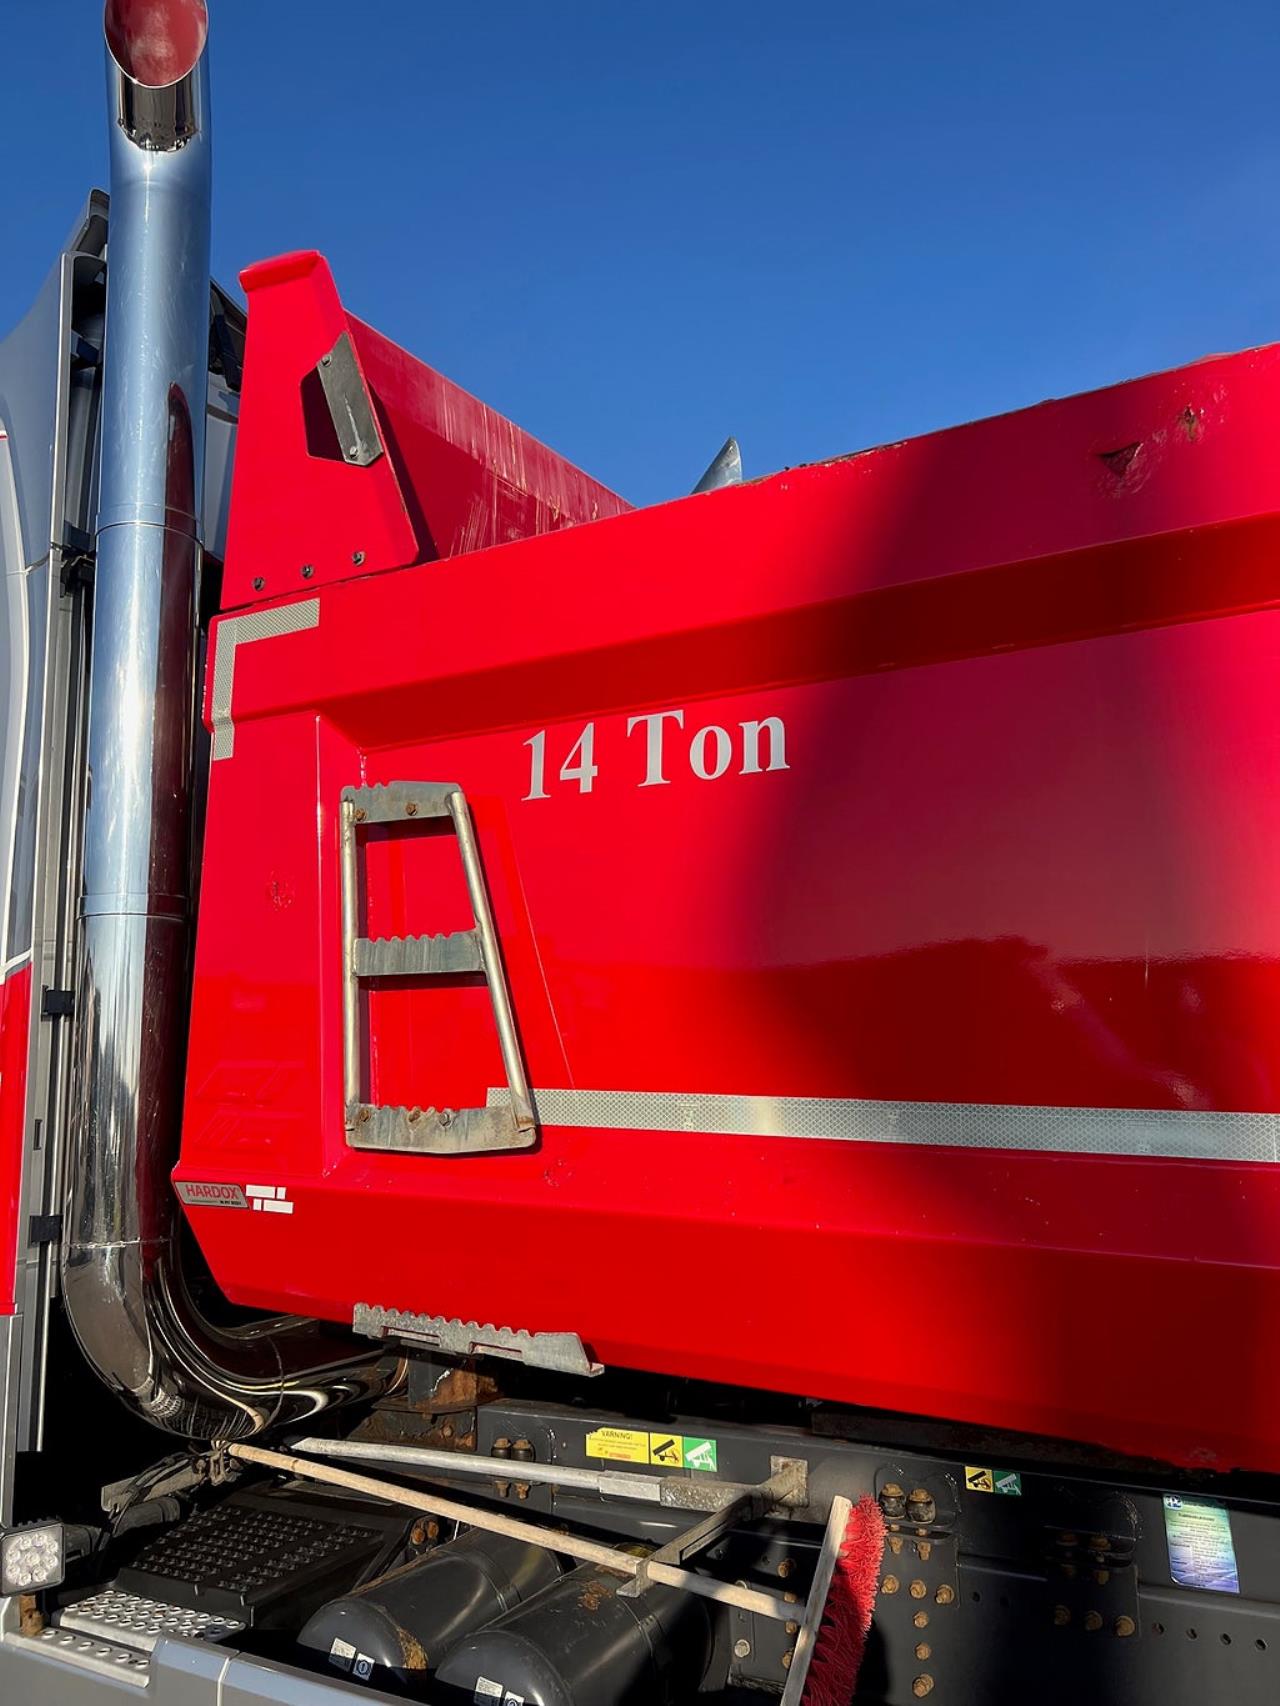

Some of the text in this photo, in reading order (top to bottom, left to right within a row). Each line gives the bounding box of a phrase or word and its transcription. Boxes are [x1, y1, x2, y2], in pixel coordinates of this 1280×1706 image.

[521, 709, 790, 801] 14 Ton
[185, 1184, 239, 1199] HARDOX
